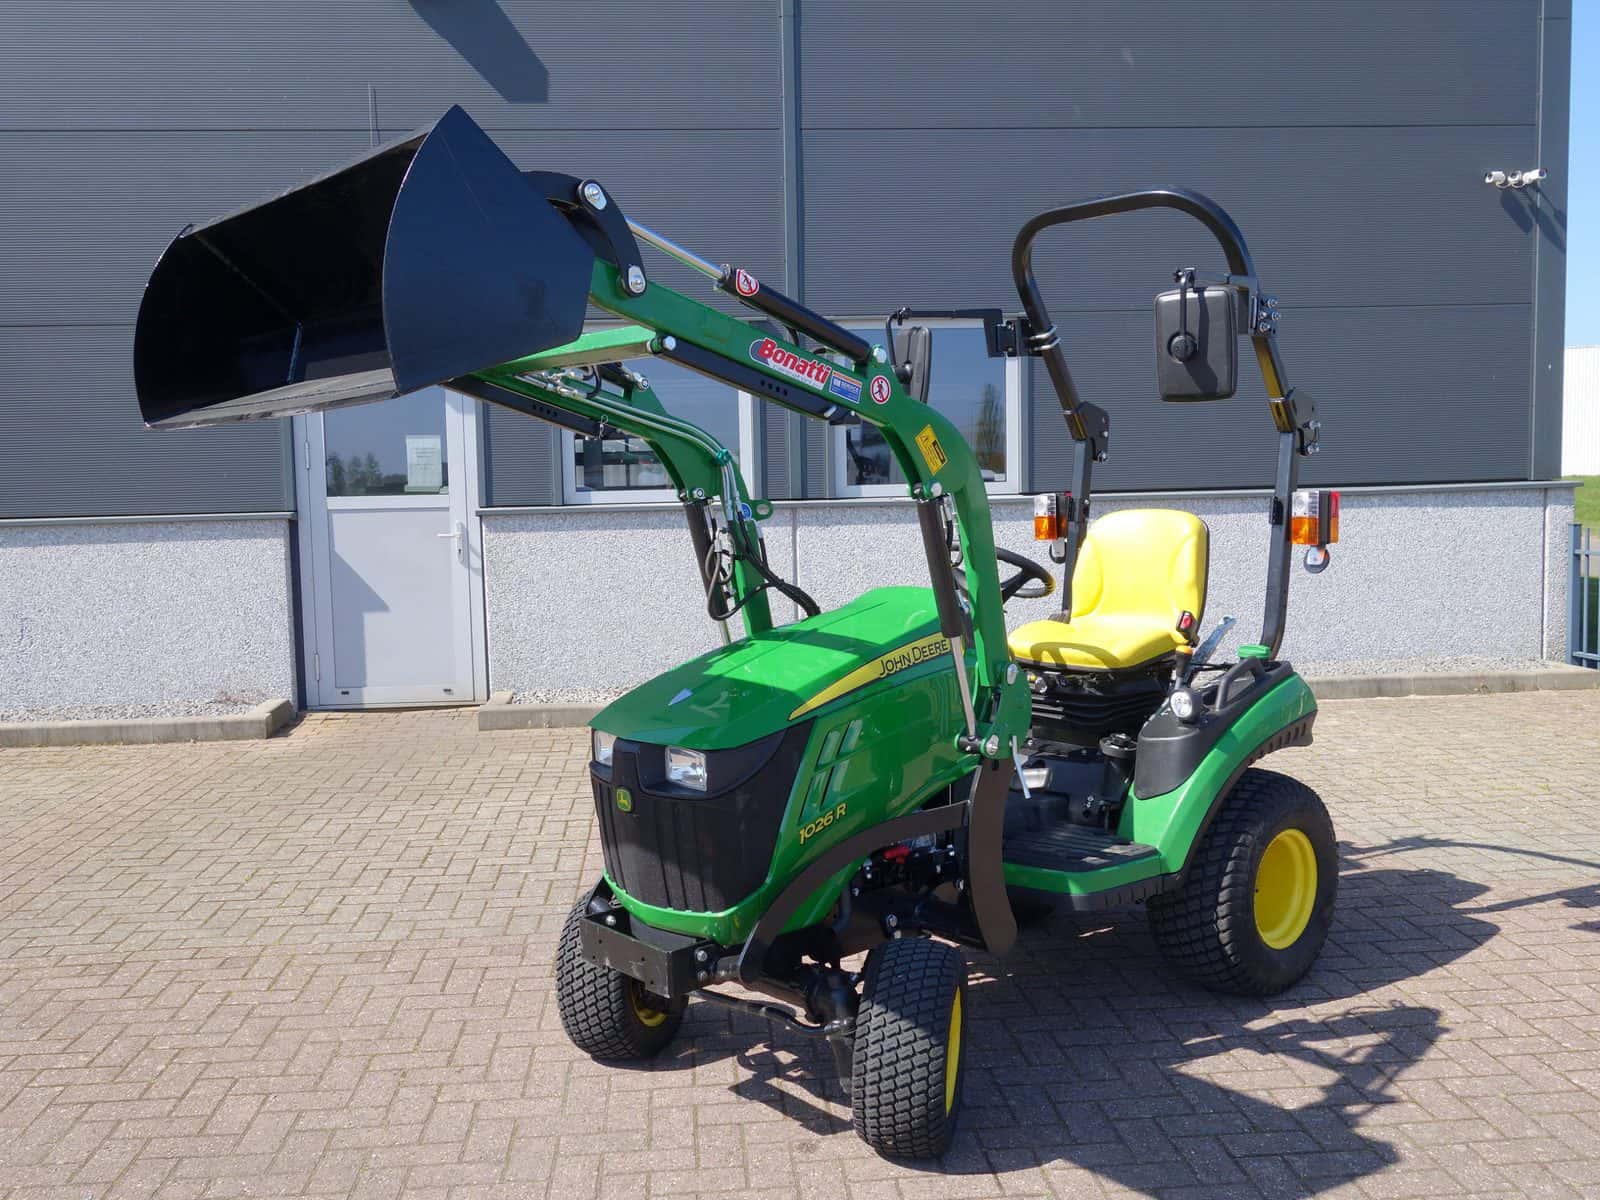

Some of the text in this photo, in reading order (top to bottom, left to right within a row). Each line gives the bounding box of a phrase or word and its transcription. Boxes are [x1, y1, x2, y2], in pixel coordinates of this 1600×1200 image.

[758, 338, 831, 384] Bonatti
[880, 640, 948, 675] JOHN DEERE
[800, 802, 847, 845] 1026 R
